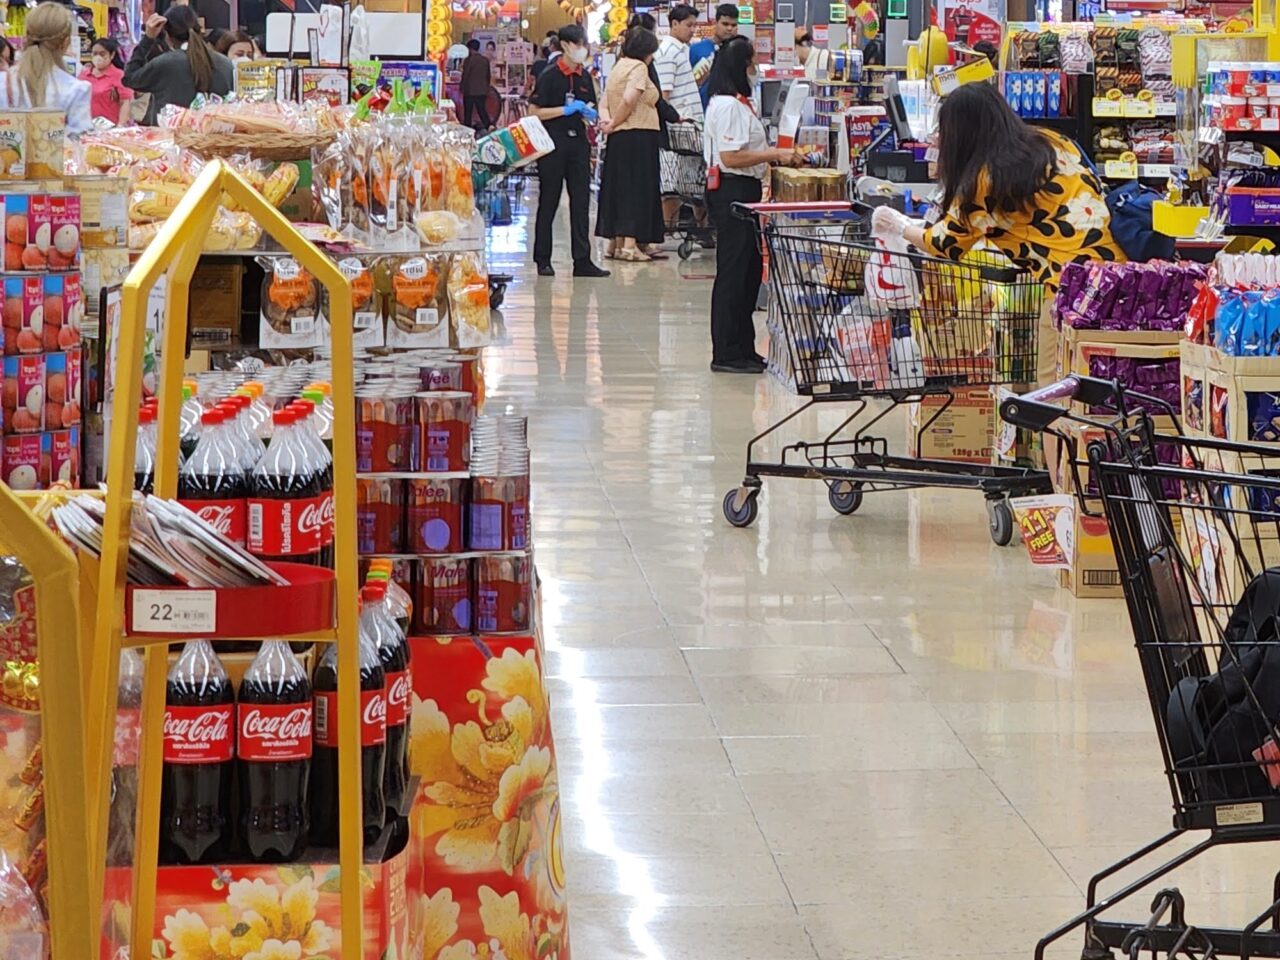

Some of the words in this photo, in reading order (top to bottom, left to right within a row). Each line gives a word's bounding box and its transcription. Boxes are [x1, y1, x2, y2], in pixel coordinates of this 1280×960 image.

[1029, 530, 1055, 552] FREE
[150, 603, 173, 621] 22
[242, 708, 312, 740] Coca-Cola
